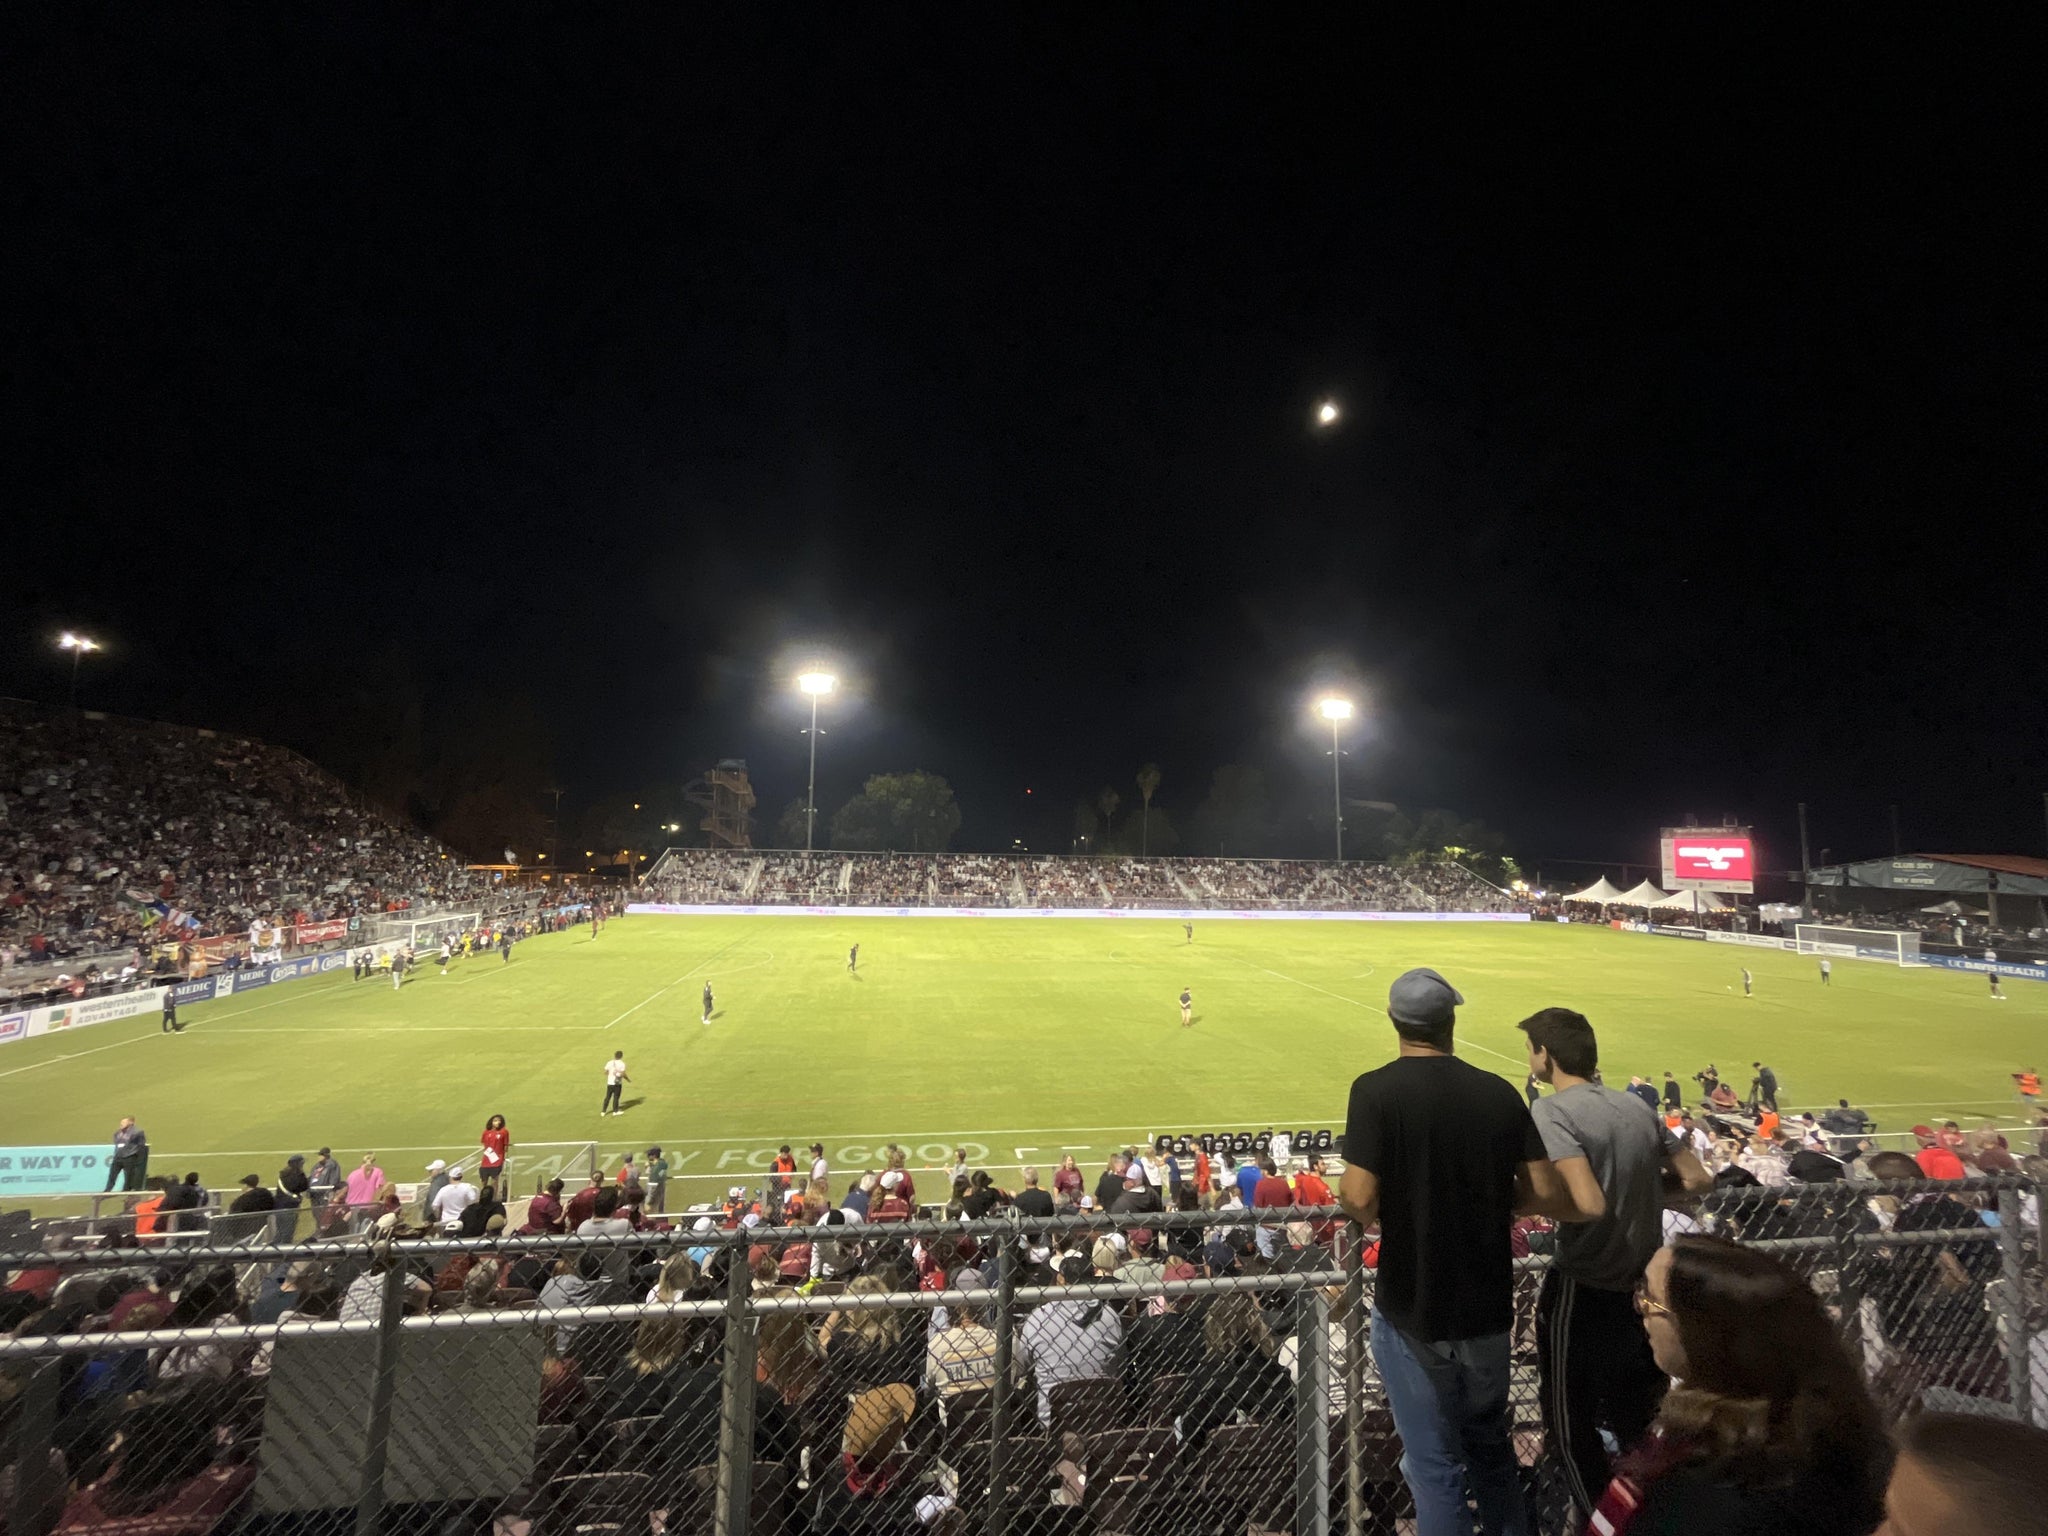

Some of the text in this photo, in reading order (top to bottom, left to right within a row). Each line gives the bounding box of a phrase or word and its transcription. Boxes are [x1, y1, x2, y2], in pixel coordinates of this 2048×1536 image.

[238, 969, 268, 983] MEDIC
[1998, 965, 2046, 978] HEALTH
[175, 981, 213, 997] MEDIC
[76, 1007, 138, 1024] ADVANTAGE
[20, 1155, 66, 1170] WAY
[70, 1154, 97, 1169] TO
[715, 1147, 814, 1169] FOR
[836, 1142, 990, 1164] GOOD
